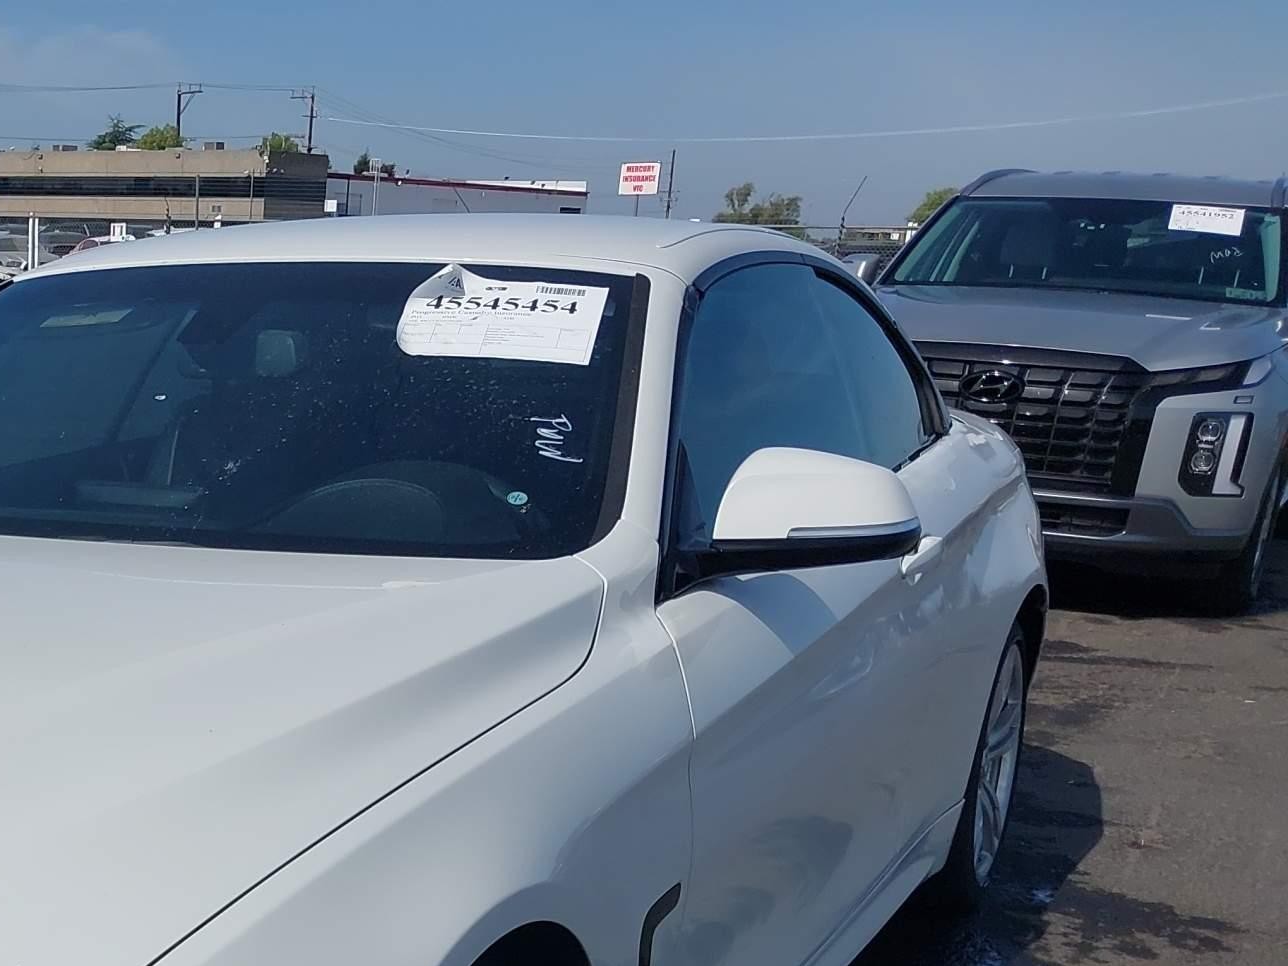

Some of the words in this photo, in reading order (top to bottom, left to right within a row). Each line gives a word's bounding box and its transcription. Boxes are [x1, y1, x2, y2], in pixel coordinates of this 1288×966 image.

[626, 165, 655, 173] MERCURY
[623, 174, 656, 183] INSURANCE
[426, 295, 578, 315] 45545454
